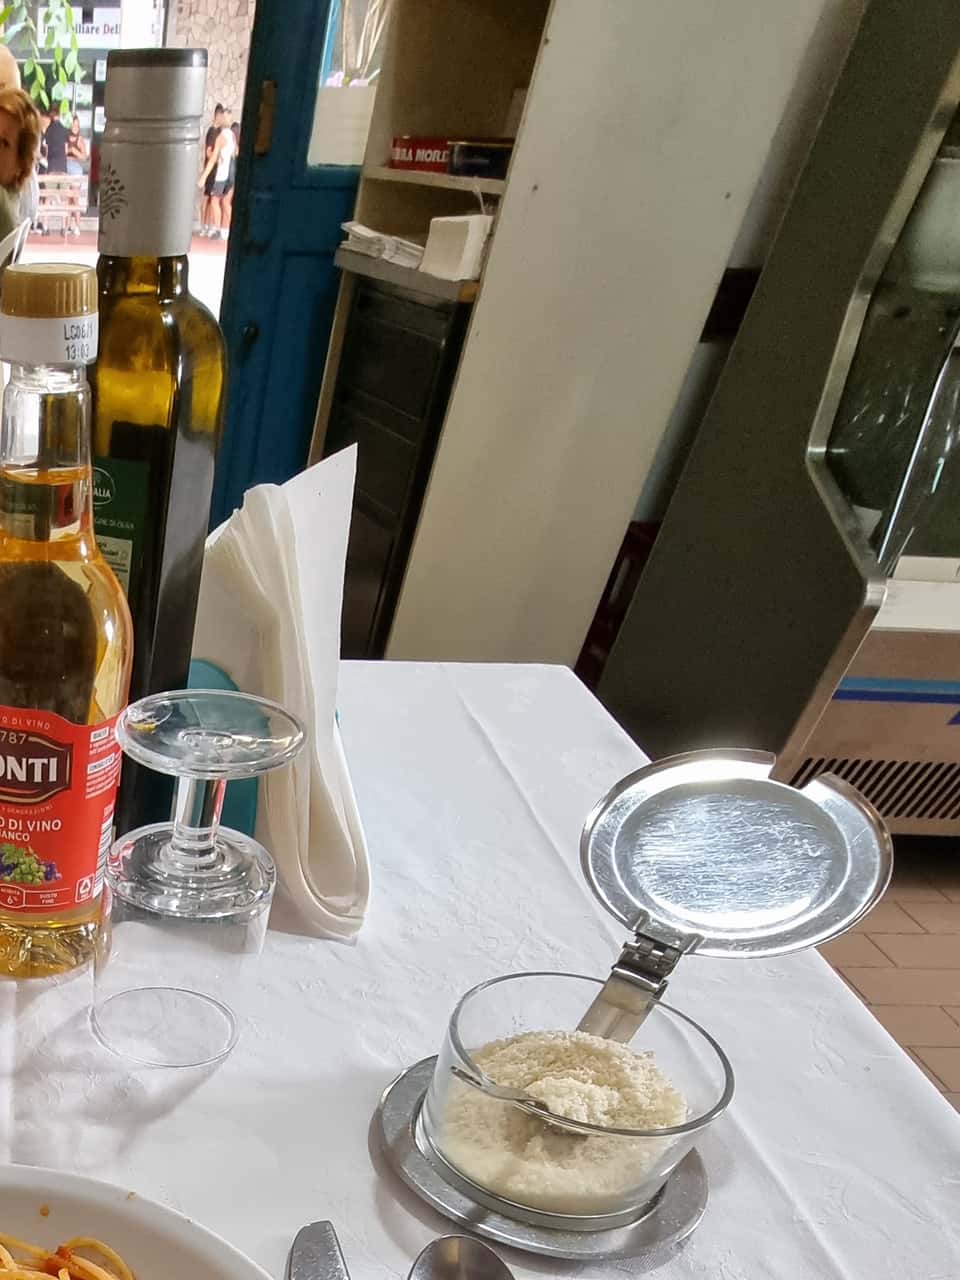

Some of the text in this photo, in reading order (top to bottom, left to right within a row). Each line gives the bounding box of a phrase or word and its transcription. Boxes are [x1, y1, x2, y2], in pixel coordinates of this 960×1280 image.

[11, 717, 22, 725] DI
[26, 719, 51, 730] VINO
[8, 818, 23, 831] DI
[26, 818, 62, 832] VINO
